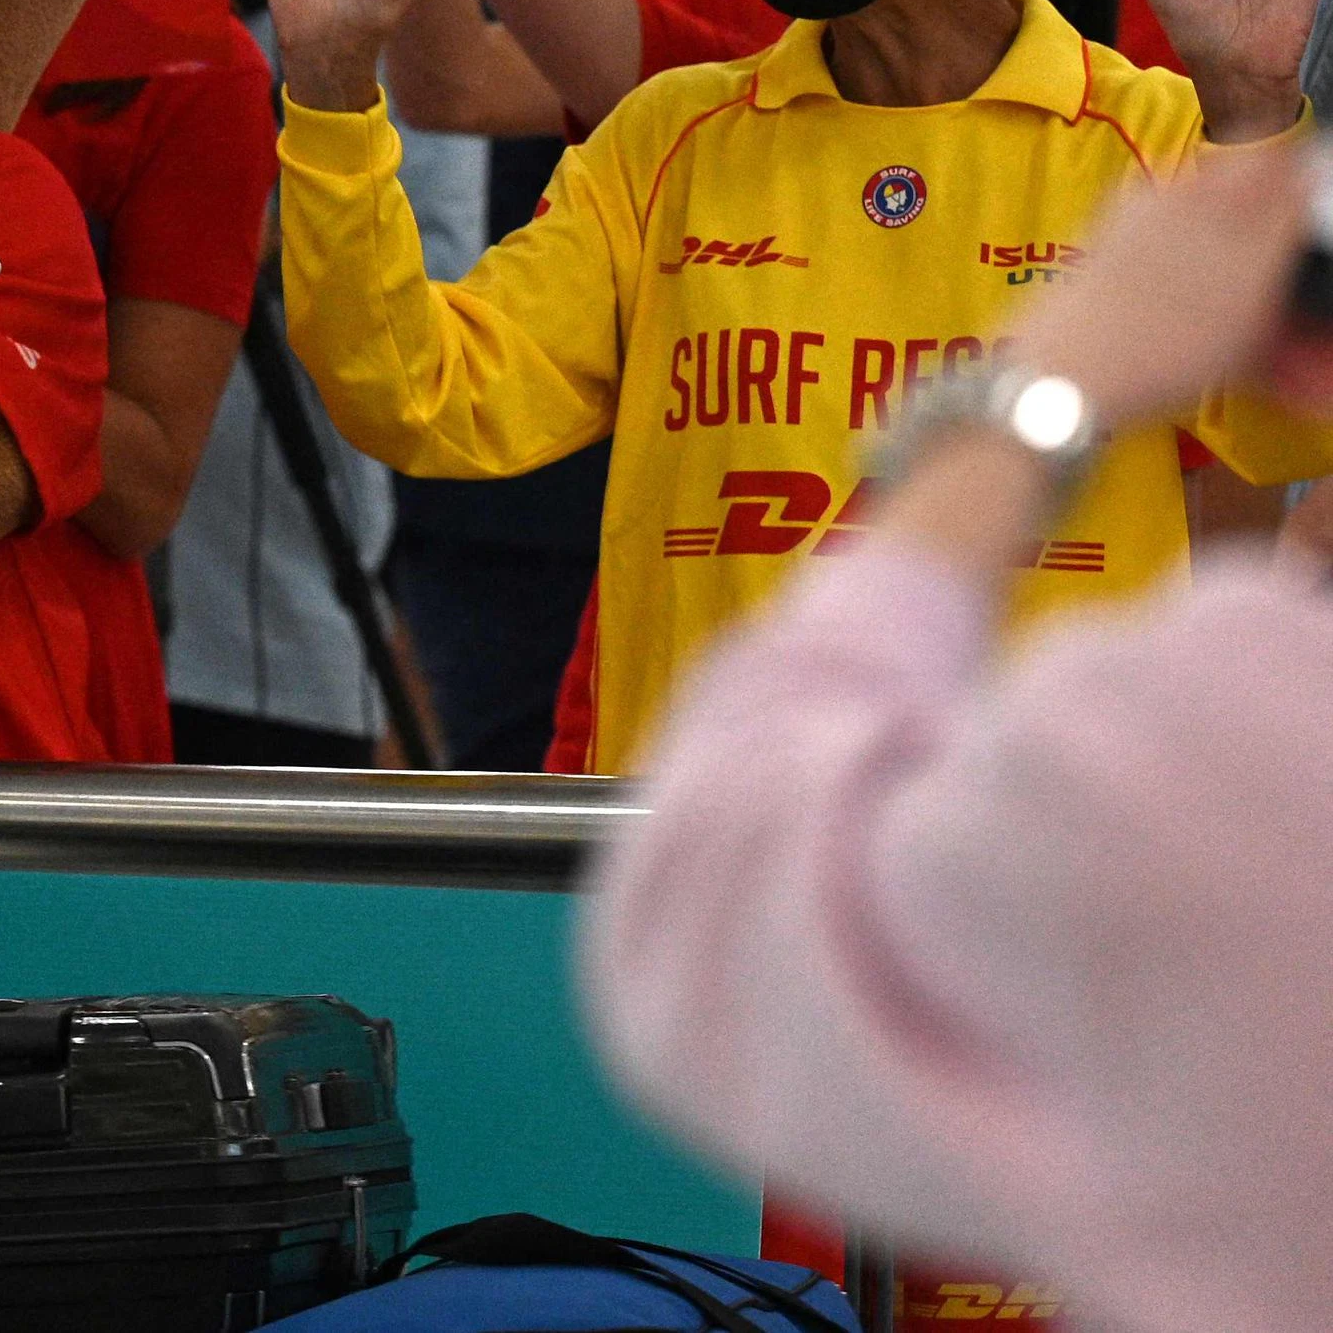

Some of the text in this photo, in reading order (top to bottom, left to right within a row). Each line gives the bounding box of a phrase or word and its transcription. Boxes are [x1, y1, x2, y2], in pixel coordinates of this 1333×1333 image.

[879, 168, 916, 179] SURF
[864, 197, 924, 227] LIFE SAVING
[980, 242, 1087, 268] ISUZ
[1007, 268, 1068, 285] UT
[664, 328, 825, 432] SURF
[935, 1283, 1063, 1319] DH
